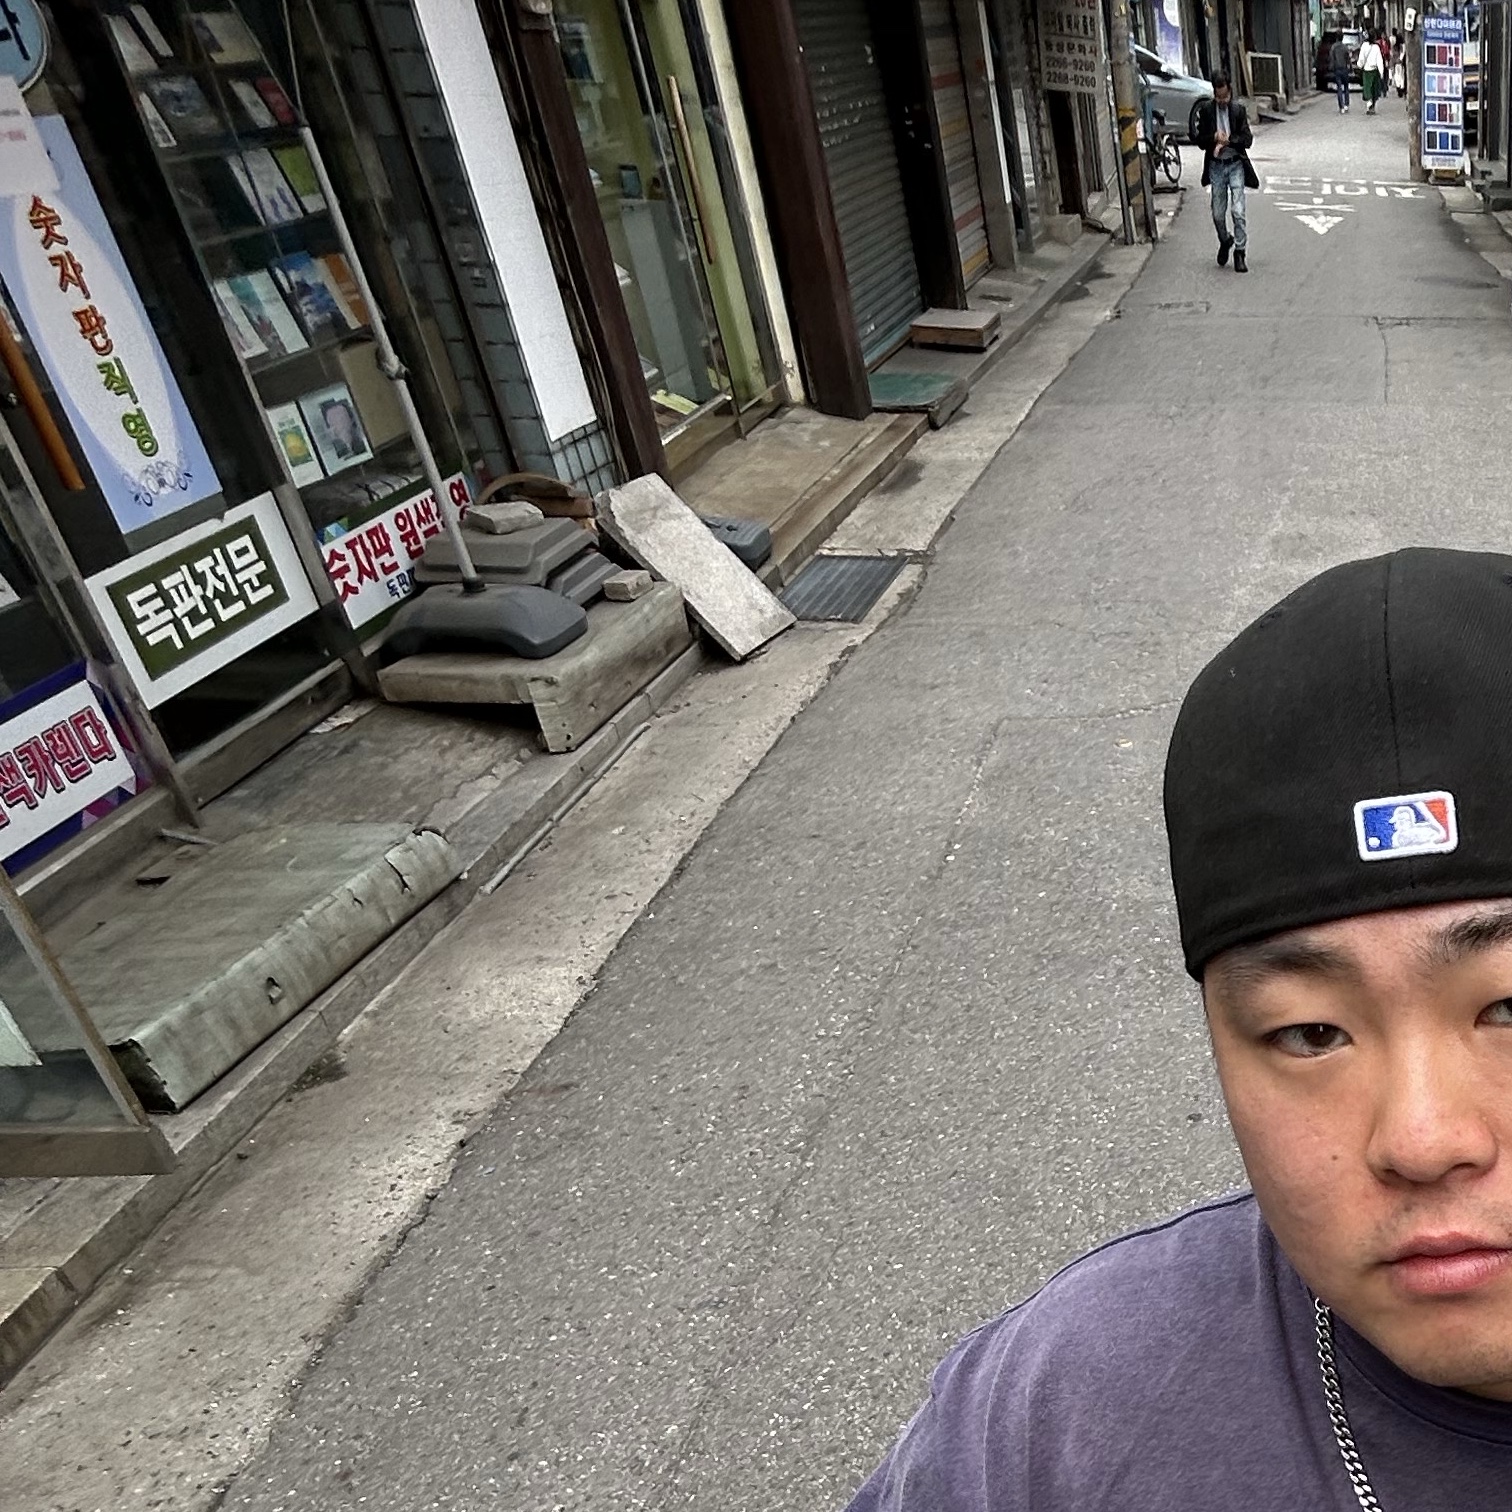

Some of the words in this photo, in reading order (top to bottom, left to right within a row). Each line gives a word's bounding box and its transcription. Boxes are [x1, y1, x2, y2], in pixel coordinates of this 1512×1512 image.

[126, 534, 275, 650] 독판전문
[327, 522, 401, 603] 숫자판
[0, 706, 117, 828] 색카렌다
